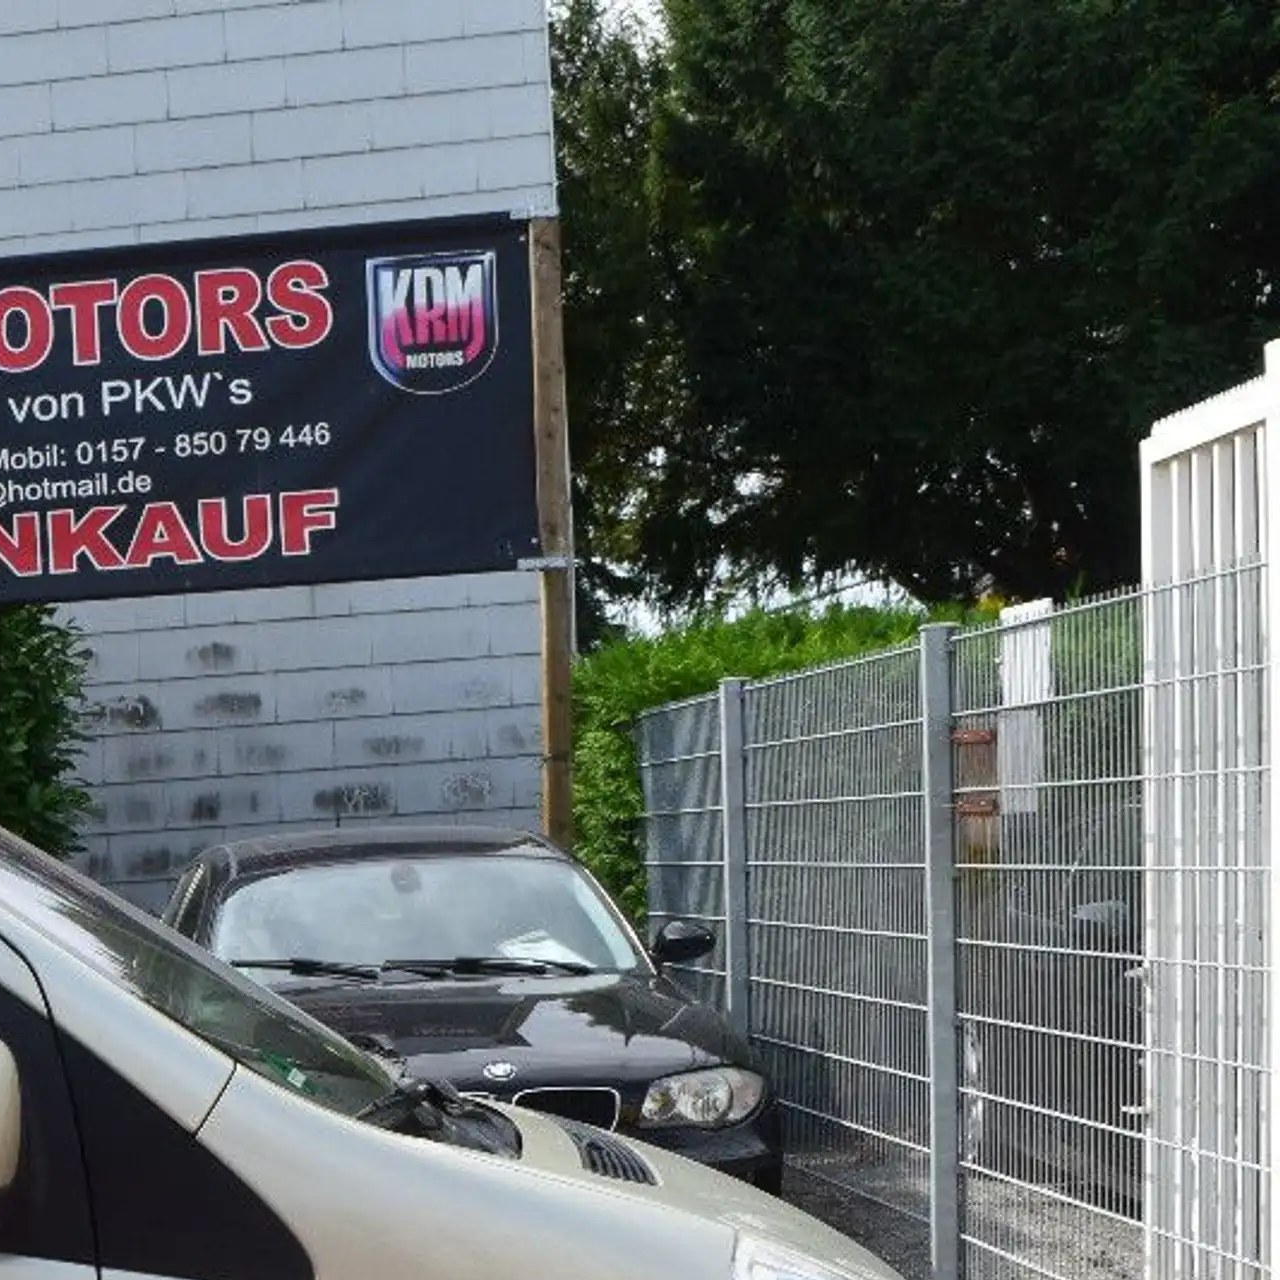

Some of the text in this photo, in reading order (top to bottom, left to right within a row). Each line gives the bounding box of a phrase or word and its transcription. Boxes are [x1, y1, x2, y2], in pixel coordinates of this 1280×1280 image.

[376, 263, 485, 369] KRM
[8, 391, 85, 423] von
[76, 437, 146, 465] 0157
[175, 431, 226, 458] 850
[236, 426, 271, 452] 79
[280, 422, 331, 447] 446
